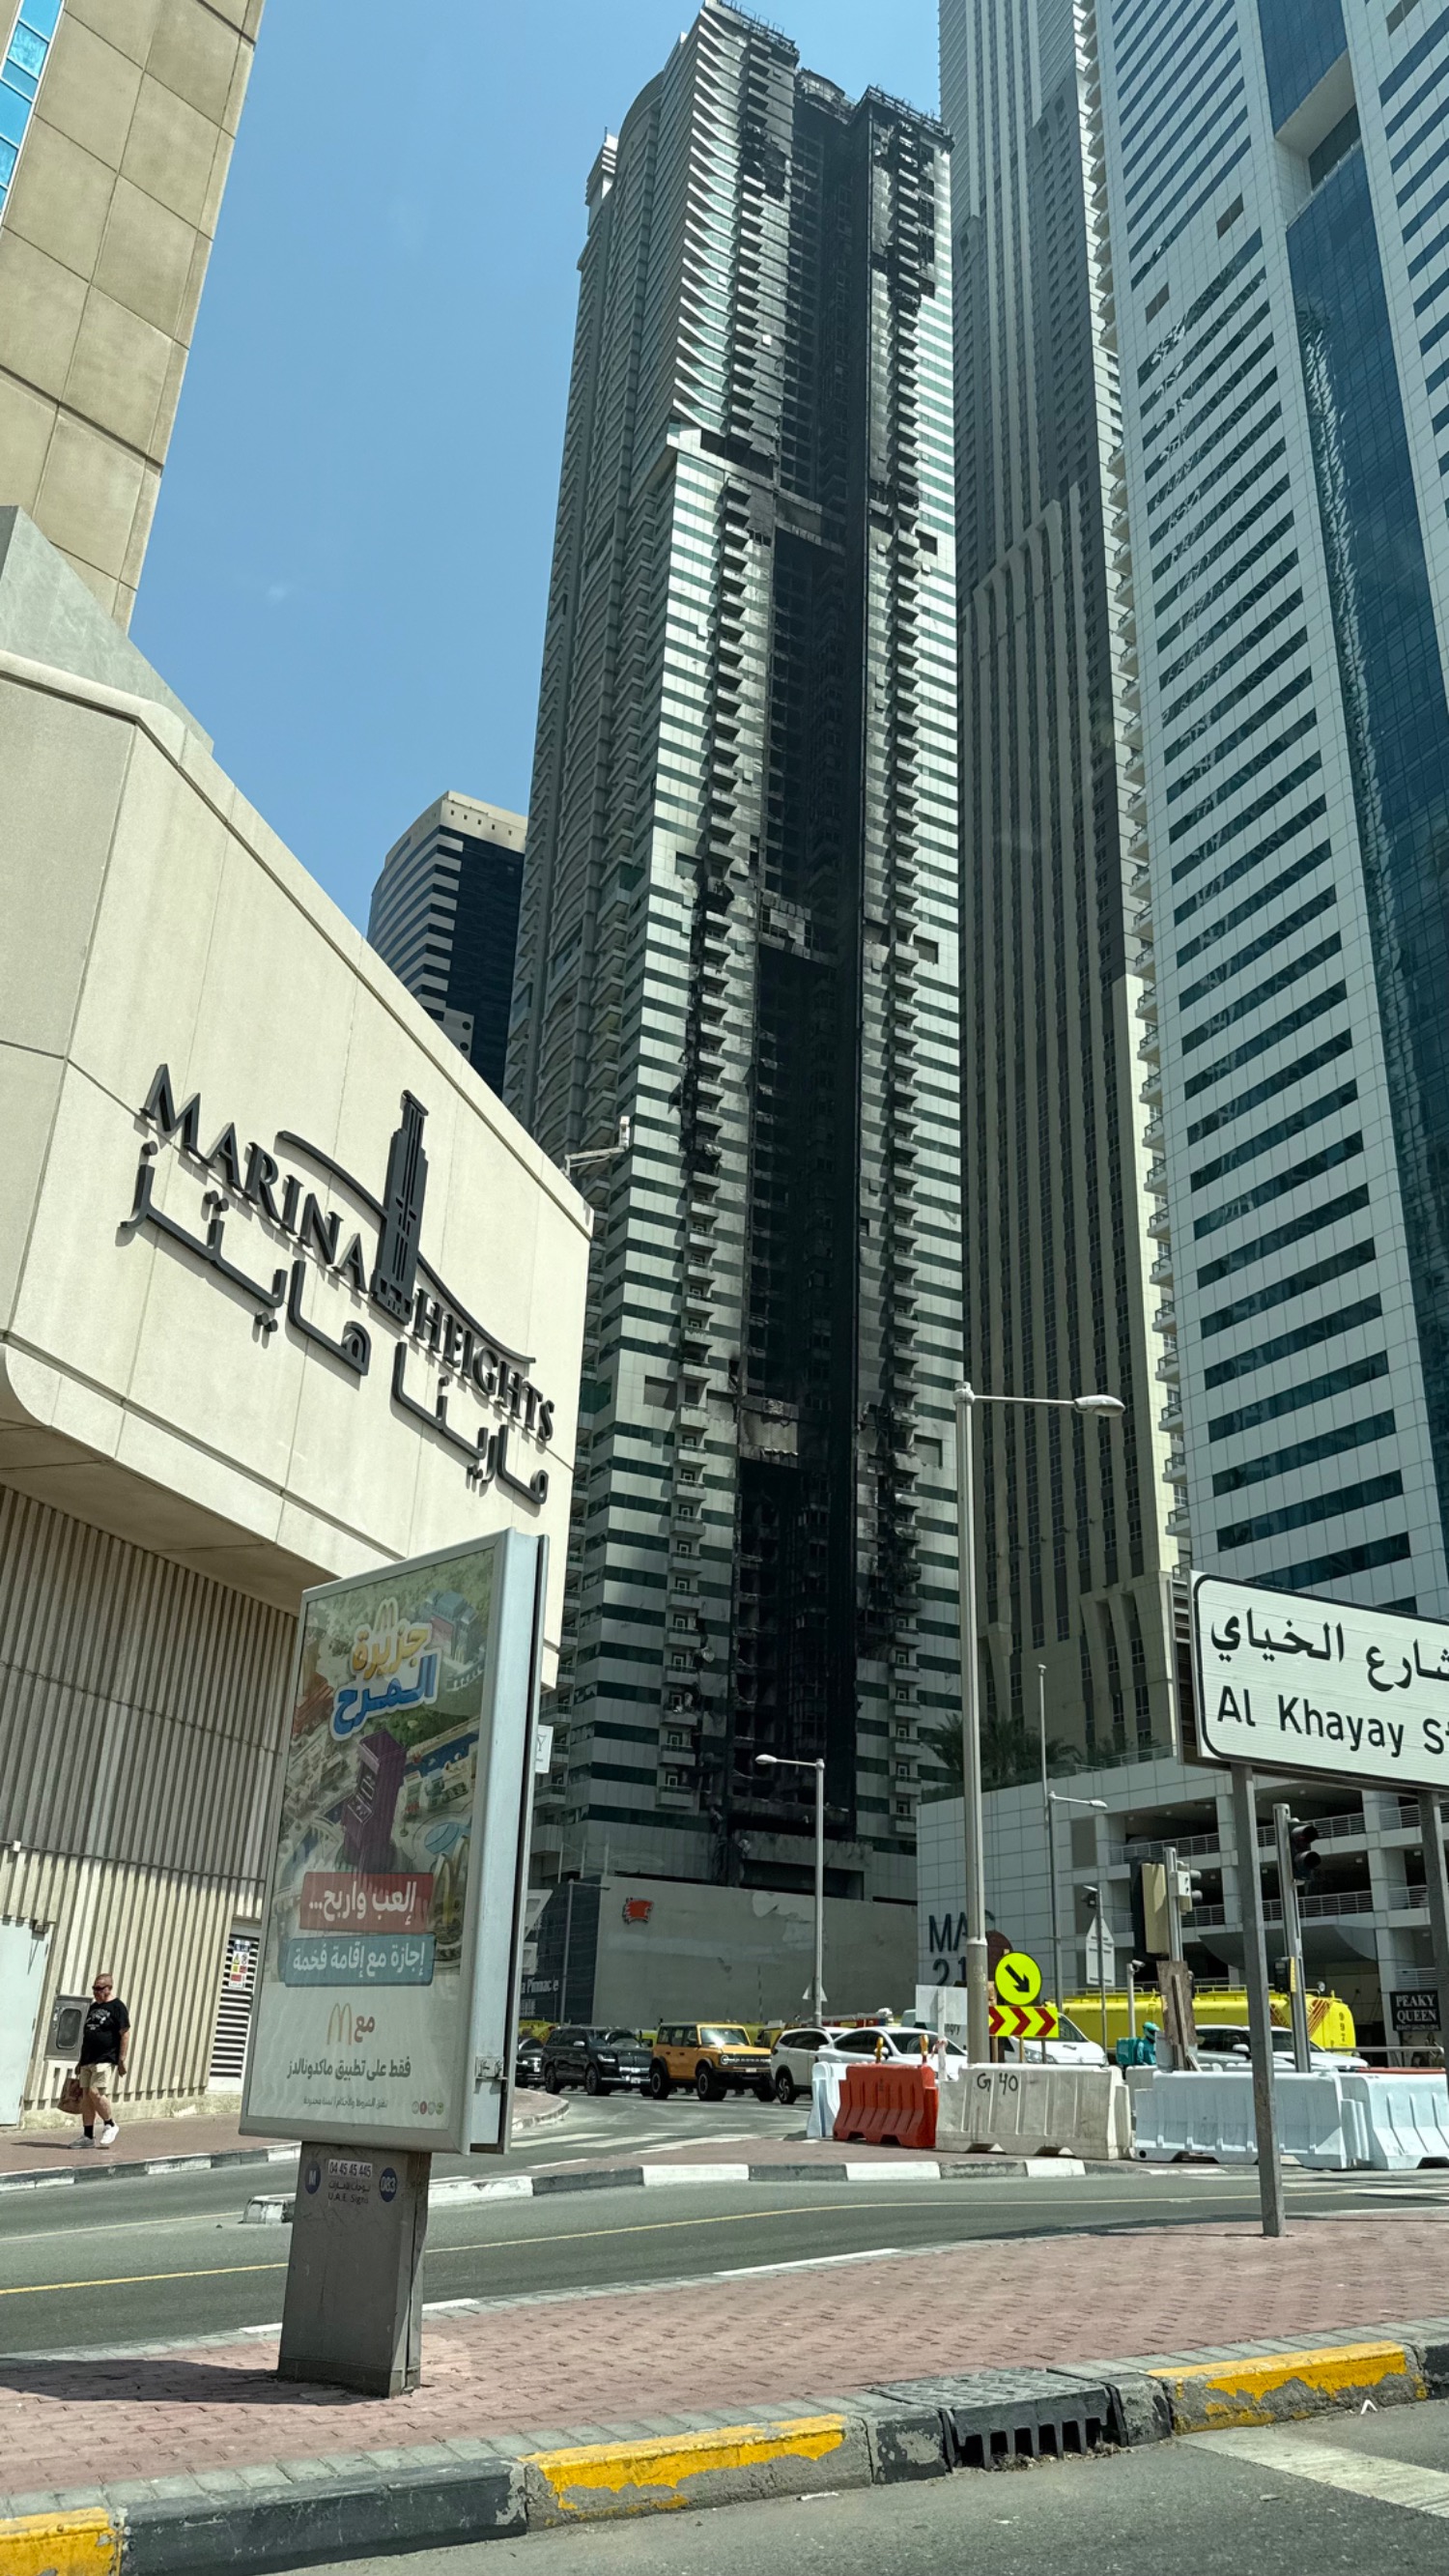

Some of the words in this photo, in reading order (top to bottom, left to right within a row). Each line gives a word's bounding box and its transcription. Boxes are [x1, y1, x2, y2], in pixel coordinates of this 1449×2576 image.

[120, 1141, 371, 1376] هايتز
[137, 1063, 370, 1296] MARINA
[412, 1287, 554, 1443] HEIGHTS
[392, 1342, 550, 1505] مارينا
[1210, 1607, 1345, 1663] الخياي
[353, 1626, 431, 1679] جزيرة
[333, 1653, 439, 1735] المرح
[1217, 1685, 1256, 1727] Al
[1278, 1694, 1404, 1758] Khayay
[366, 1951, 387, 1977] مع
[390, 1942, 425, 1977] إجازة
[1395, 1994, 1435, 2008] PEAKY
[354, 2016, 376, 2044] مع
[1397, 2010, 1437, 2024] QUEEN
[335, 2058, 366, 2081] تطبيق
[366, 2059, 387, 2081] على
[388, 2055, 412, 2077] فقط
[998, 2072, 1019, 2096] 40
